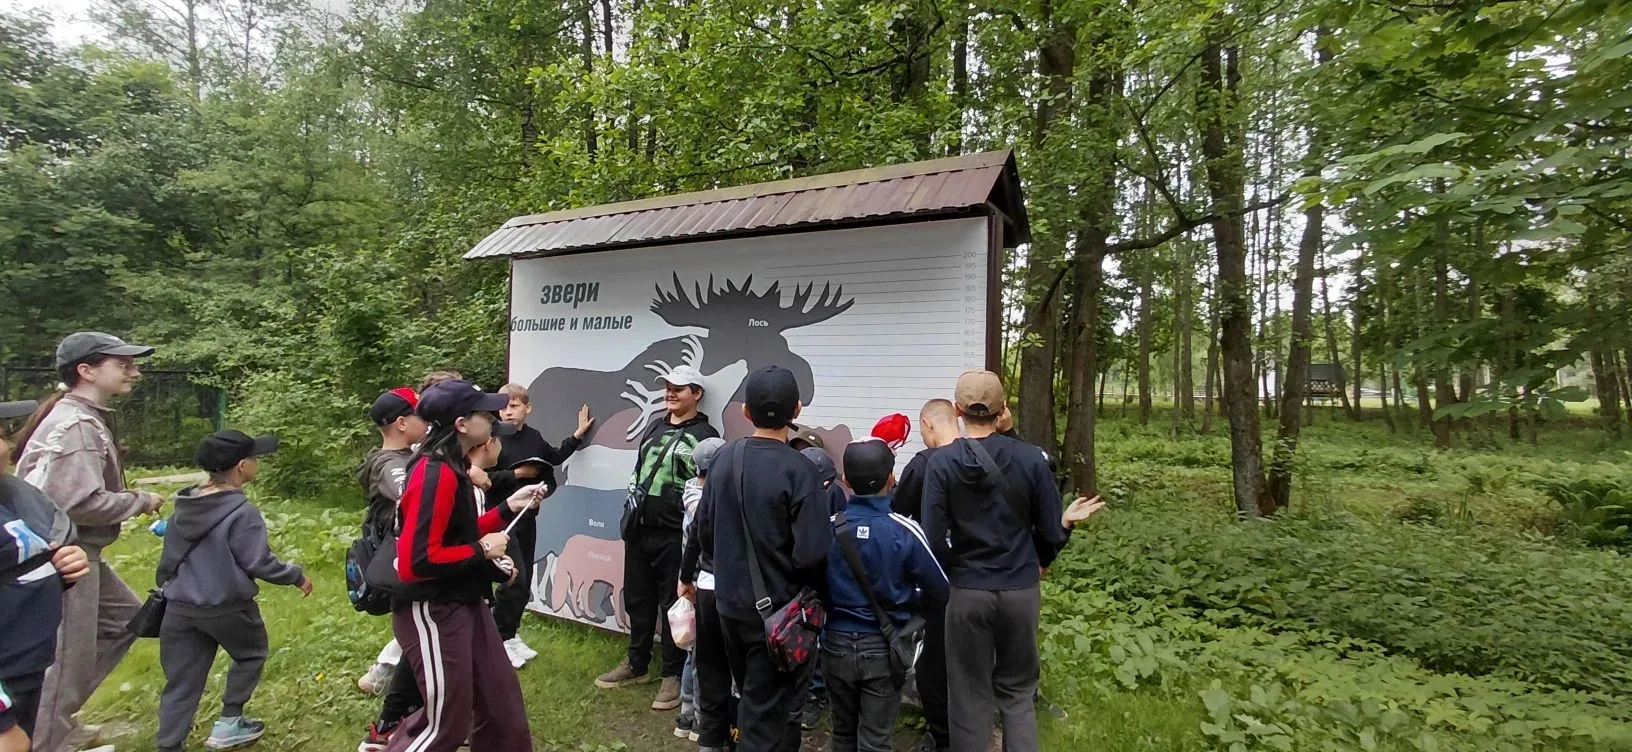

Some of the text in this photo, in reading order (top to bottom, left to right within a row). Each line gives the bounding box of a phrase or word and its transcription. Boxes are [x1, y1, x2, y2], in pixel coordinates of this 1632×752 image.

[963, 251, 977, 259] 200
[964, 273, 977, 281] 190
[540, 281, 600, 309] звери
[510, 315, 633, 332] большие и малые
[748, 318, 769, 327] Лось
[963, 329, 976, 337] 165
[963, 351, 976, 359] 155
[588, 518, 605, 528] Волк
